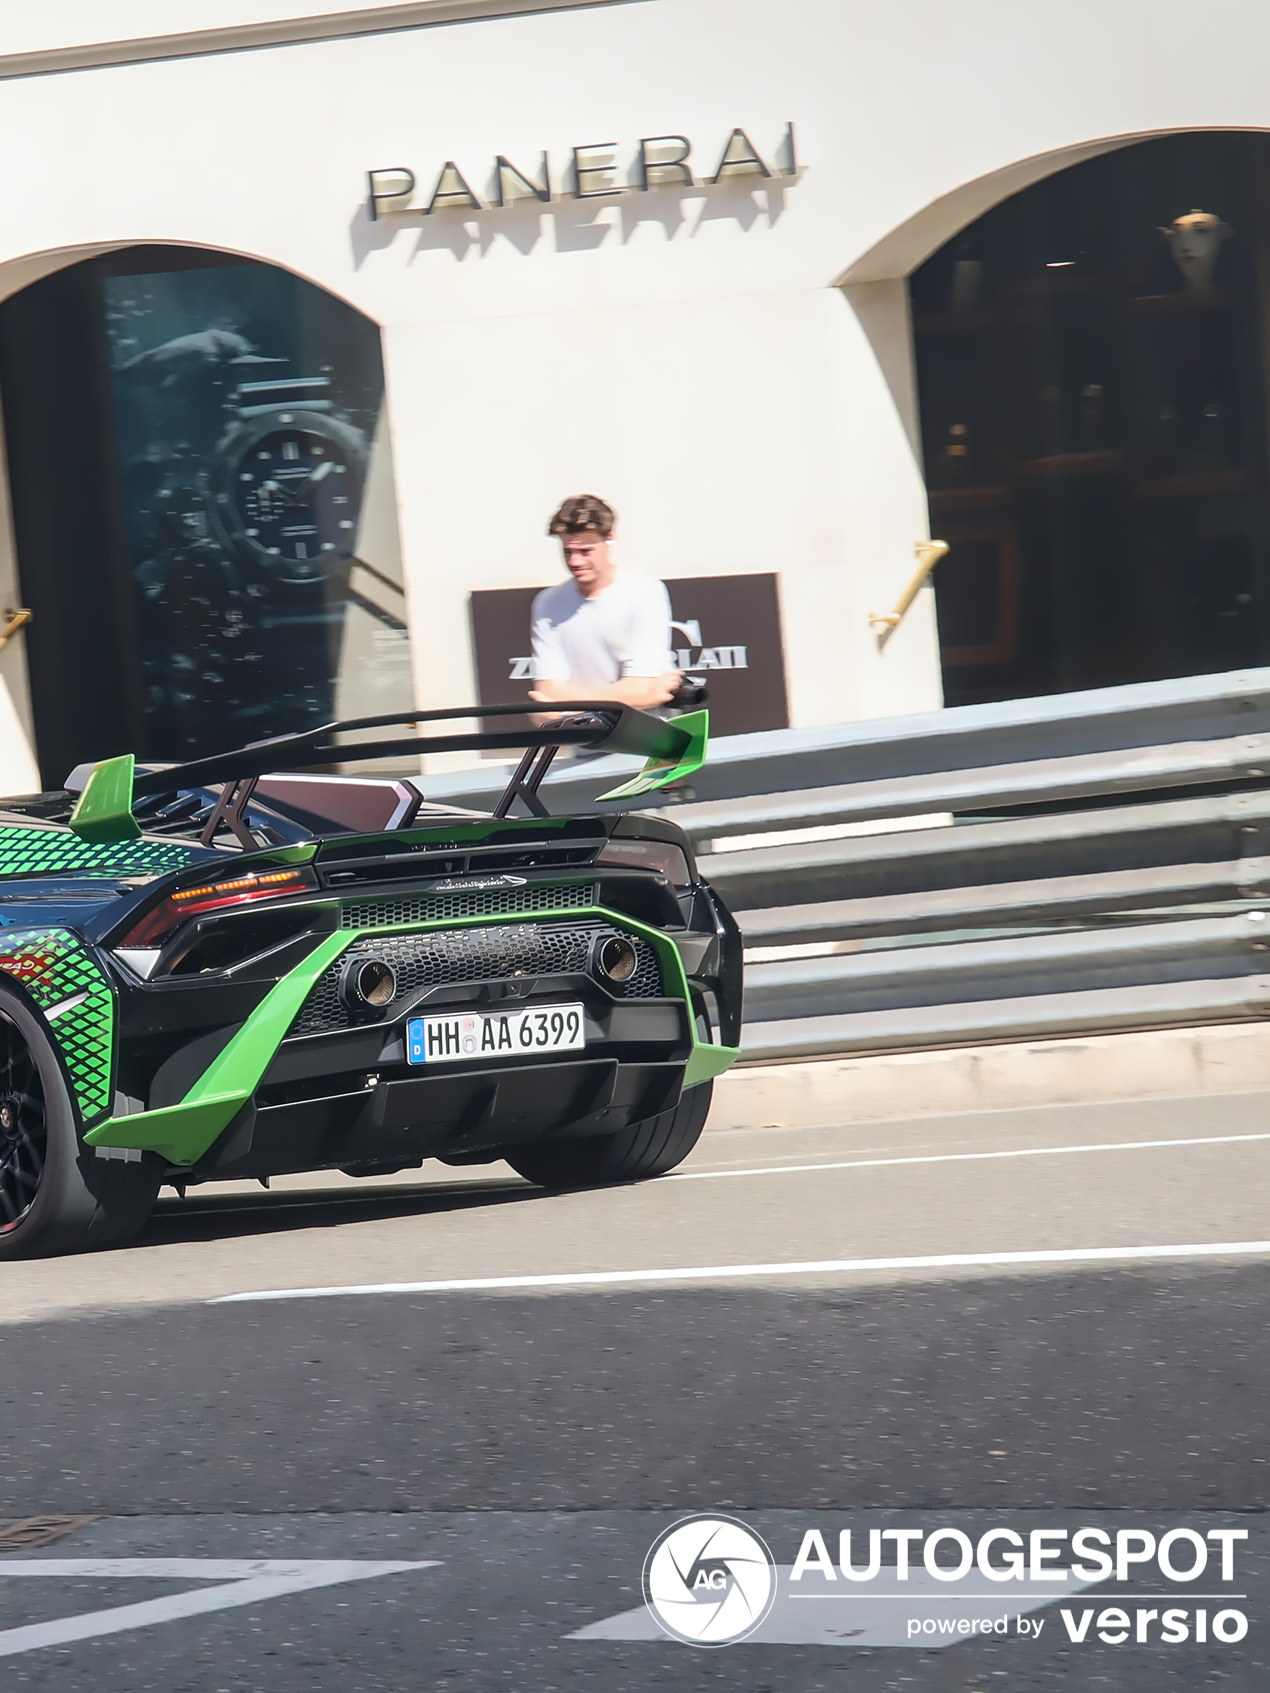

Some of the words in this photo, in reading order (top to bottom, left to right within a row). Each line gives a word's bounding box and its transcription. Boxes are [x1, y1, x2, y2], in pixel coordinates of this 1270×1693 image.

[366, 121, 797, 221] PANERAI
[427, 1021, 460, 1056] HH
[481, 1016, 513, 1051] AA
[518, 1011, 580, 1048] 6399
